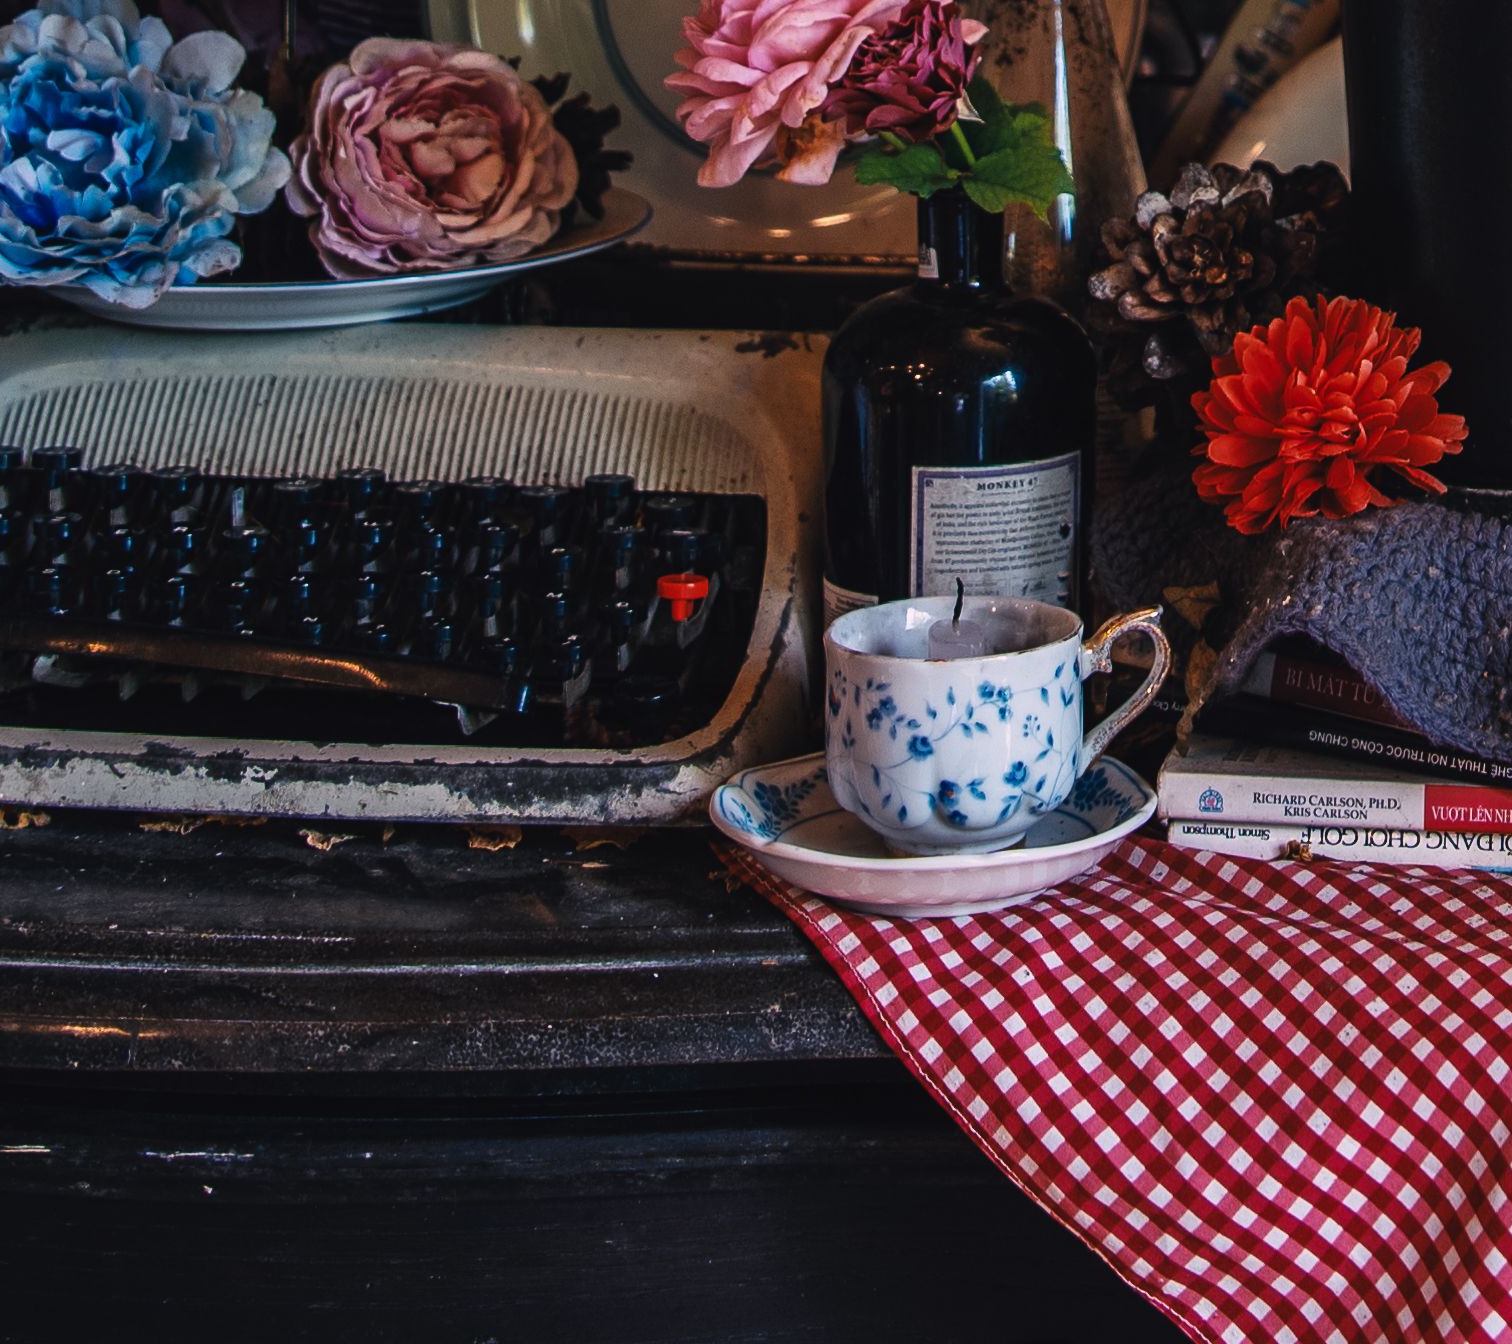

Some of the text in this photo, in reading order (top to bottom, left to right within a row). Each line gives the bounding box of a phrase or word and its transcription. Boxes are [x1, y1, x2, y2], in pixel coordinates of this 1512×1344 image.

[977, 479, 1025, 491] MONKEY
[1253, 792, 1307, 806] RICHARD
[1309, 795, 1367, 810] CARLSON,
[1284, 805, 1368, 820] KRIS CARLSON
[1182, 825, 1270, 840] Simon Thompson
[1301, 826, 1359, 847] GOLF
